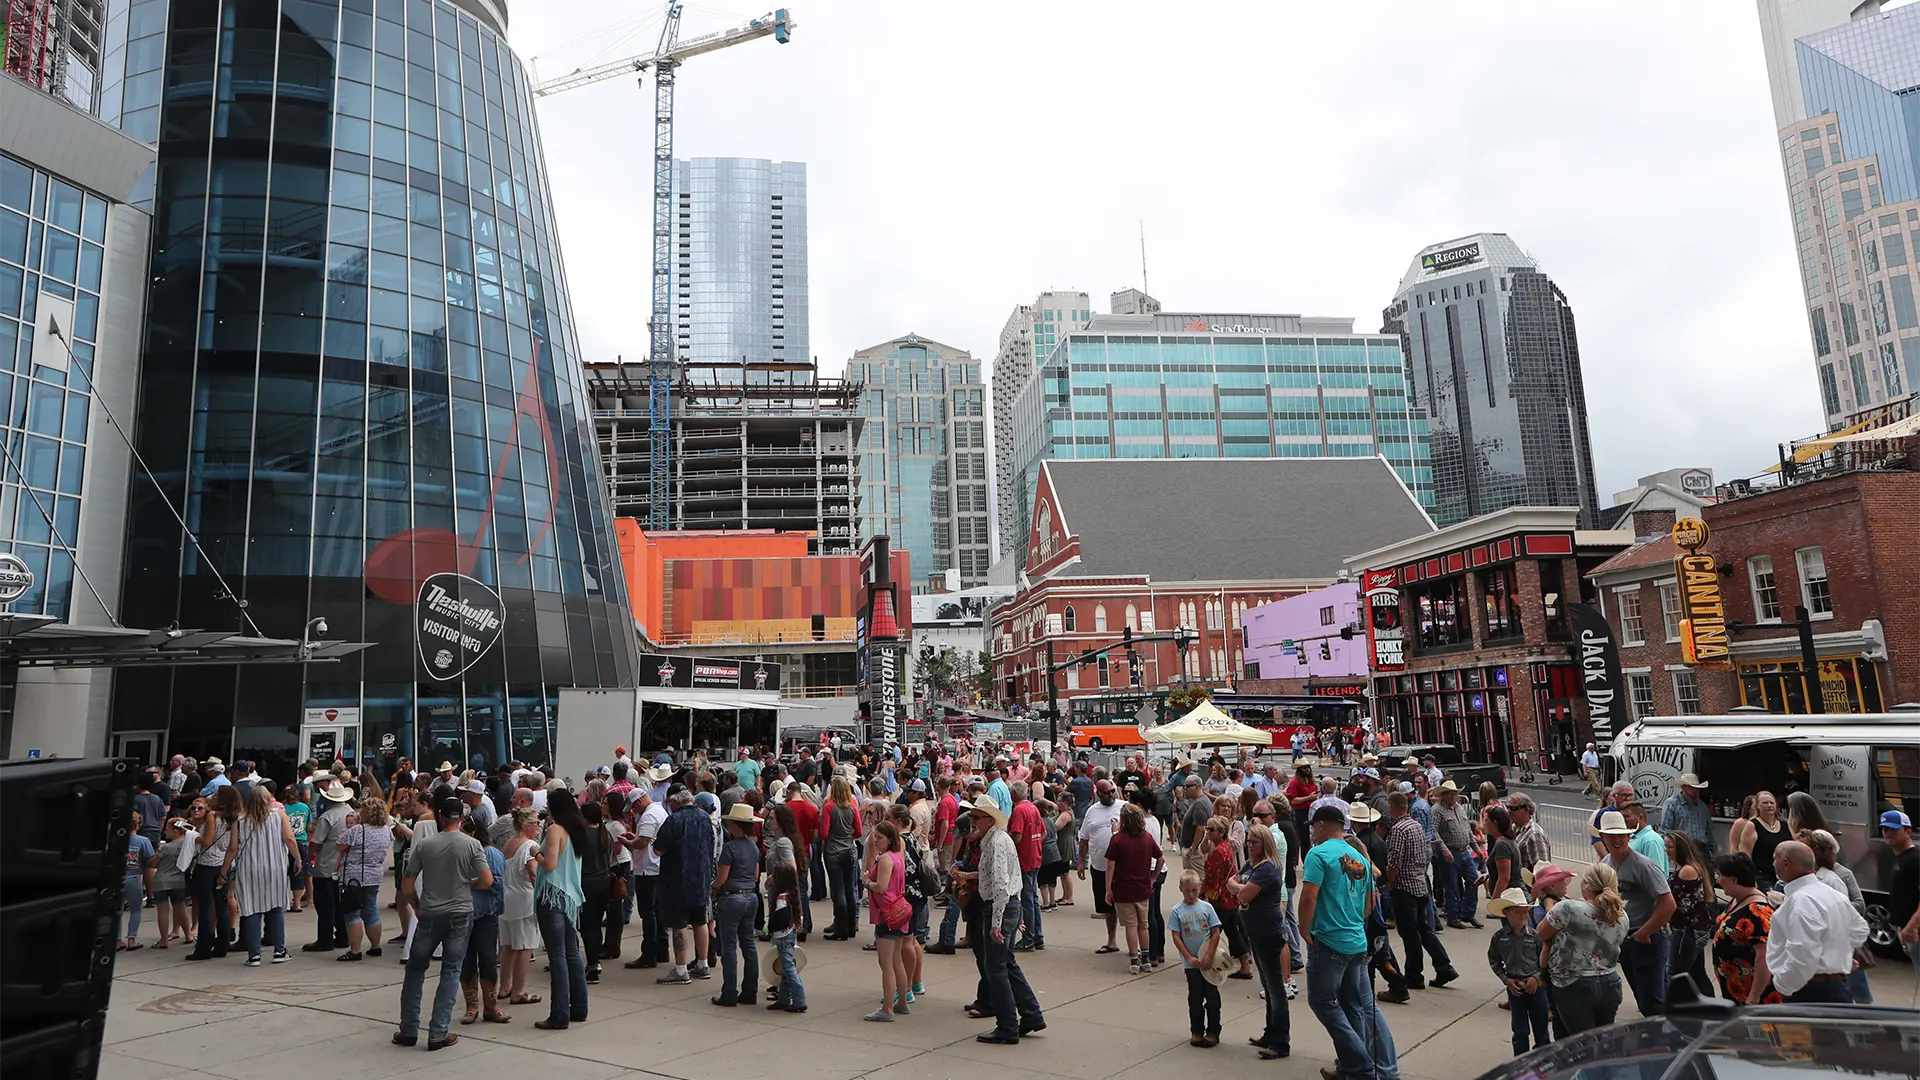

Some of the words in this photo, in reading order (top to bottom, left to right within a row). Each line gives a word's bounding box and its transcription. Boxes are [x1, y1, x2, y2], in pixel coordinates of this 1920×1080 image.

[1434, 246, 1478, 264] REGIONS
[1684, 476, 1708, 487] CMT
[1372, 593, 1399, 607] RIBS
[426, 584, 500, 631] Nashville
[1682, 556, 1729, 660] CANTINA
[434, 605, 460, 620] MUSIC
[464, 618, 481, 629] CITY
[423, 618, 460, 643] VISITOR
[460, 634, 482, 653] INFO
[1375, 640, 1403, 653] HONKY
[1377, 652, 1405, 665] TONK
[1581, 629, 1609, 683] JACK
[1315, 686, 1361, 696] LEGENDS
[1197, 717, 1238, 726] Coors
[1638, 779, 1652, 788] Old
